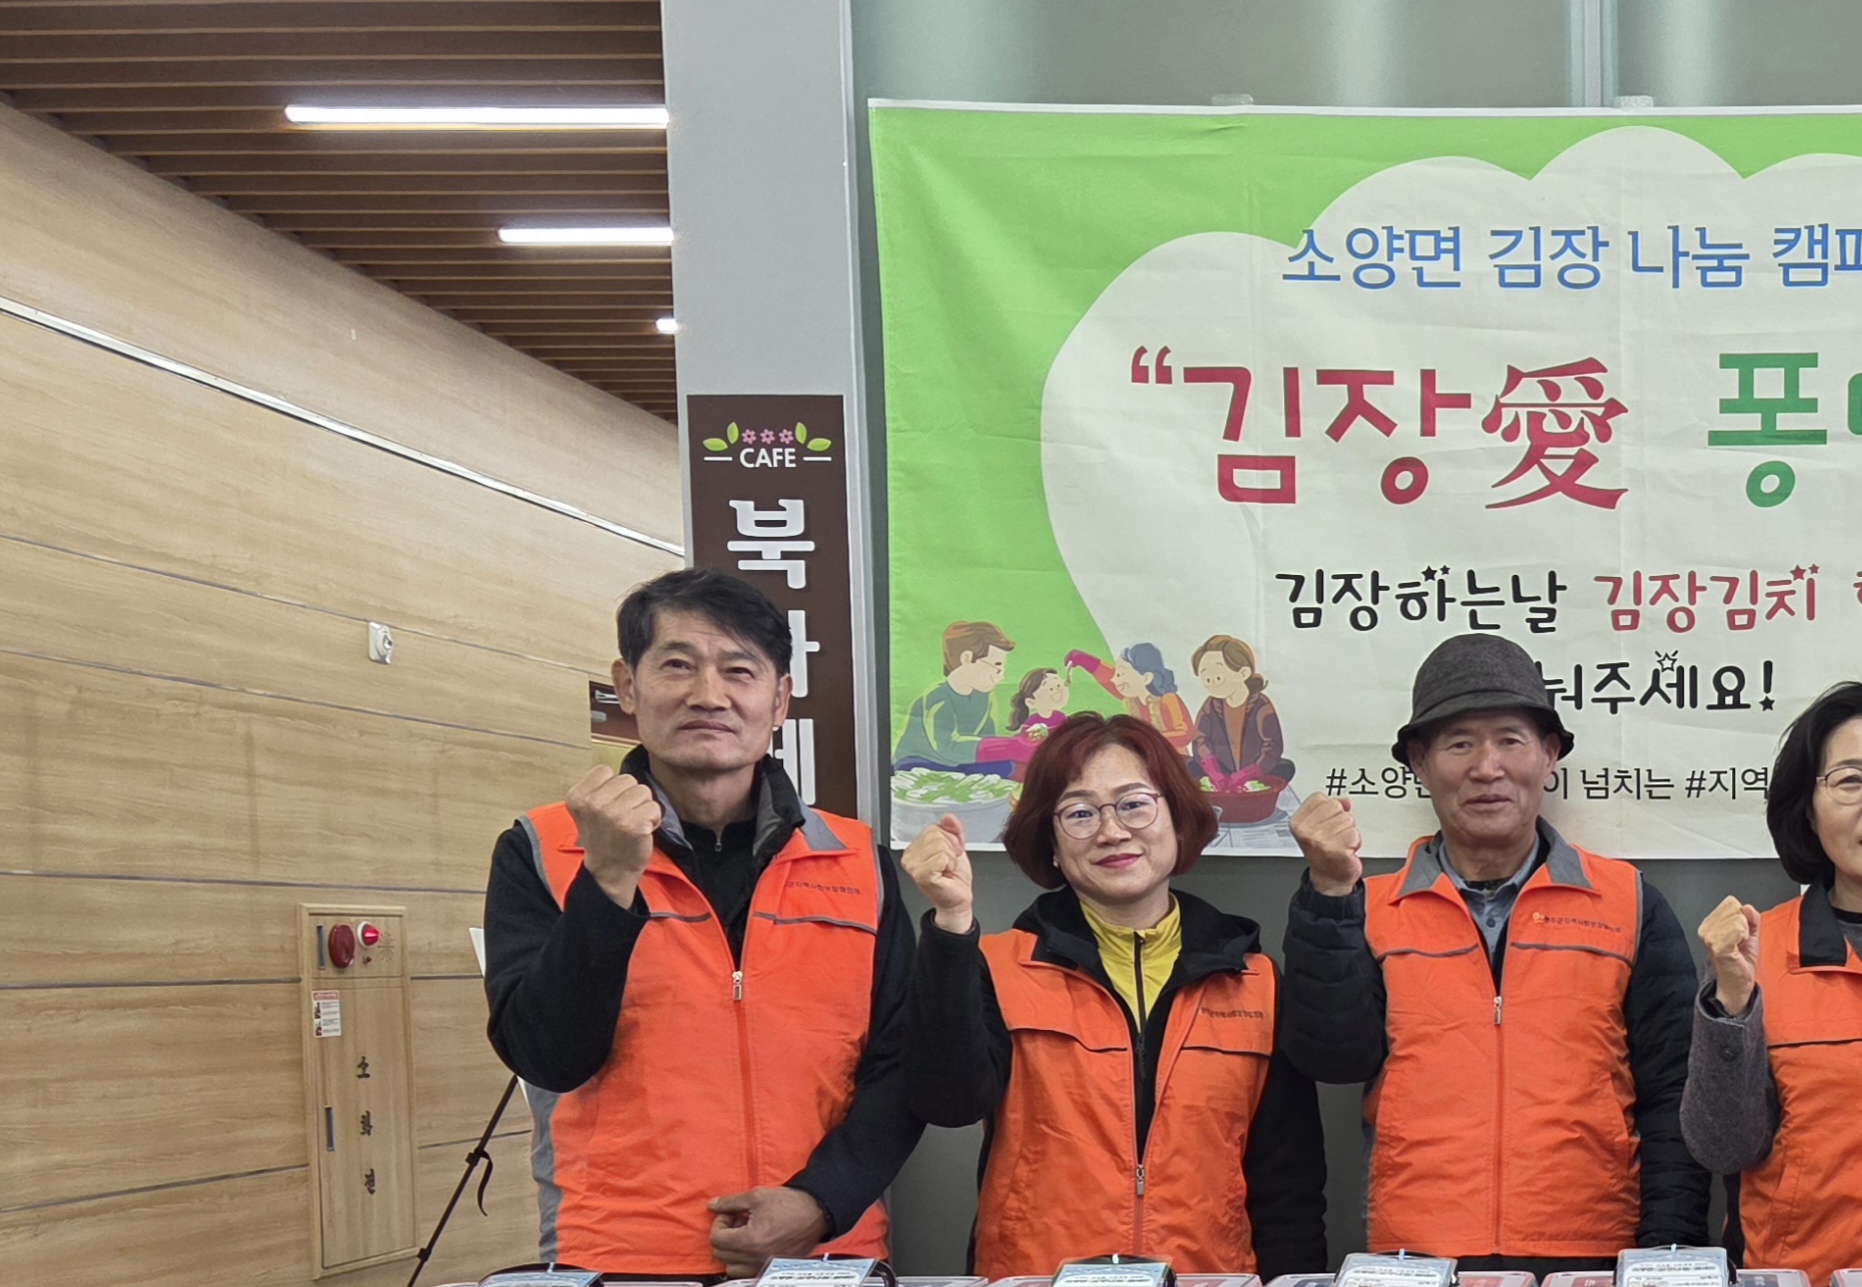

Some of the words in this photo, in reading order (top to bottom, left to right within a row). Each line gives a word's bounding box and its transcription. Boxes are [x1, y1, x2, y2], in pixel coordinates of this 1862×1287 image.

[1282, 225, 1462, 290] 소양면
[1488, 225, 1610, 290] 김장
[1627, 224, 1751, 289] 나눔
[739, 447, 797, 469] CAFE
[1130, 344, 1630, 512] “김장愛
[1275, 565, 1568, 634] 김장하는날
[1593, 563, 1820, 633] 김장김치
[1534, 650, 1777, 715] 눠주세요!
[1579, 767, 1676, 801] 넘치는
